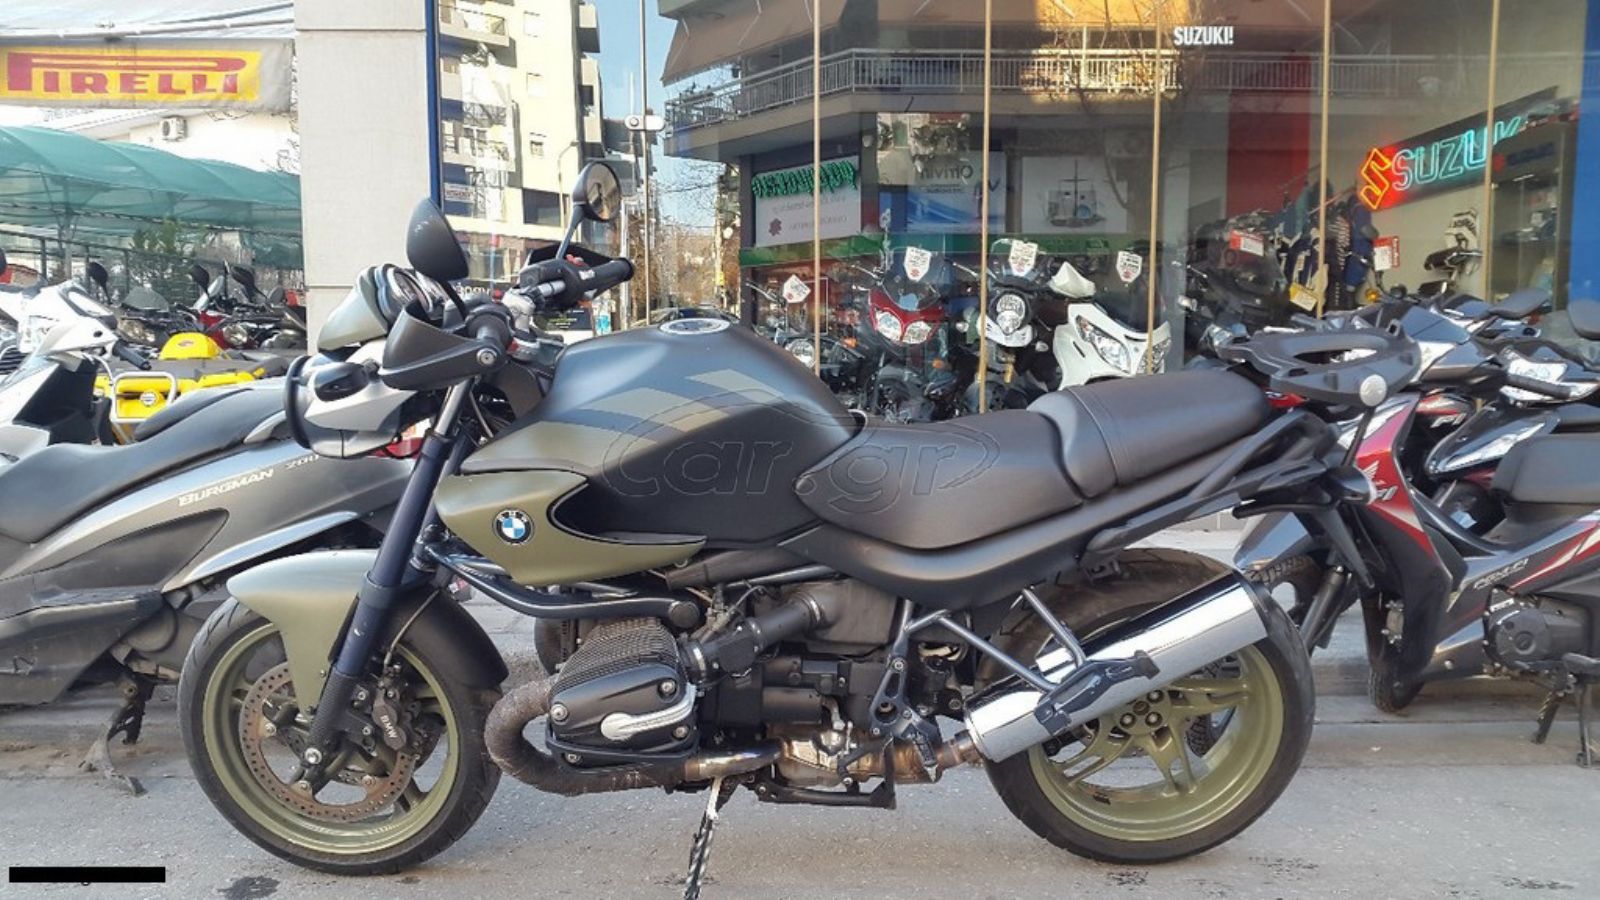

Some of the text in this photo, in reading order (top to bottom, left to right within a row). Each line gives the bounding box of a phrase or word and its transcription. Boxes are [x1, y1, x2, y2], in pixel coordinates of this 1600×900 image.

[1173, 25, 1234, 46] SUZUKI!
[7, 52, 247, 95] PIRELLI
[178, 468, 275, 507] BURGMAN
[380, 714, 398, 739] BMW
